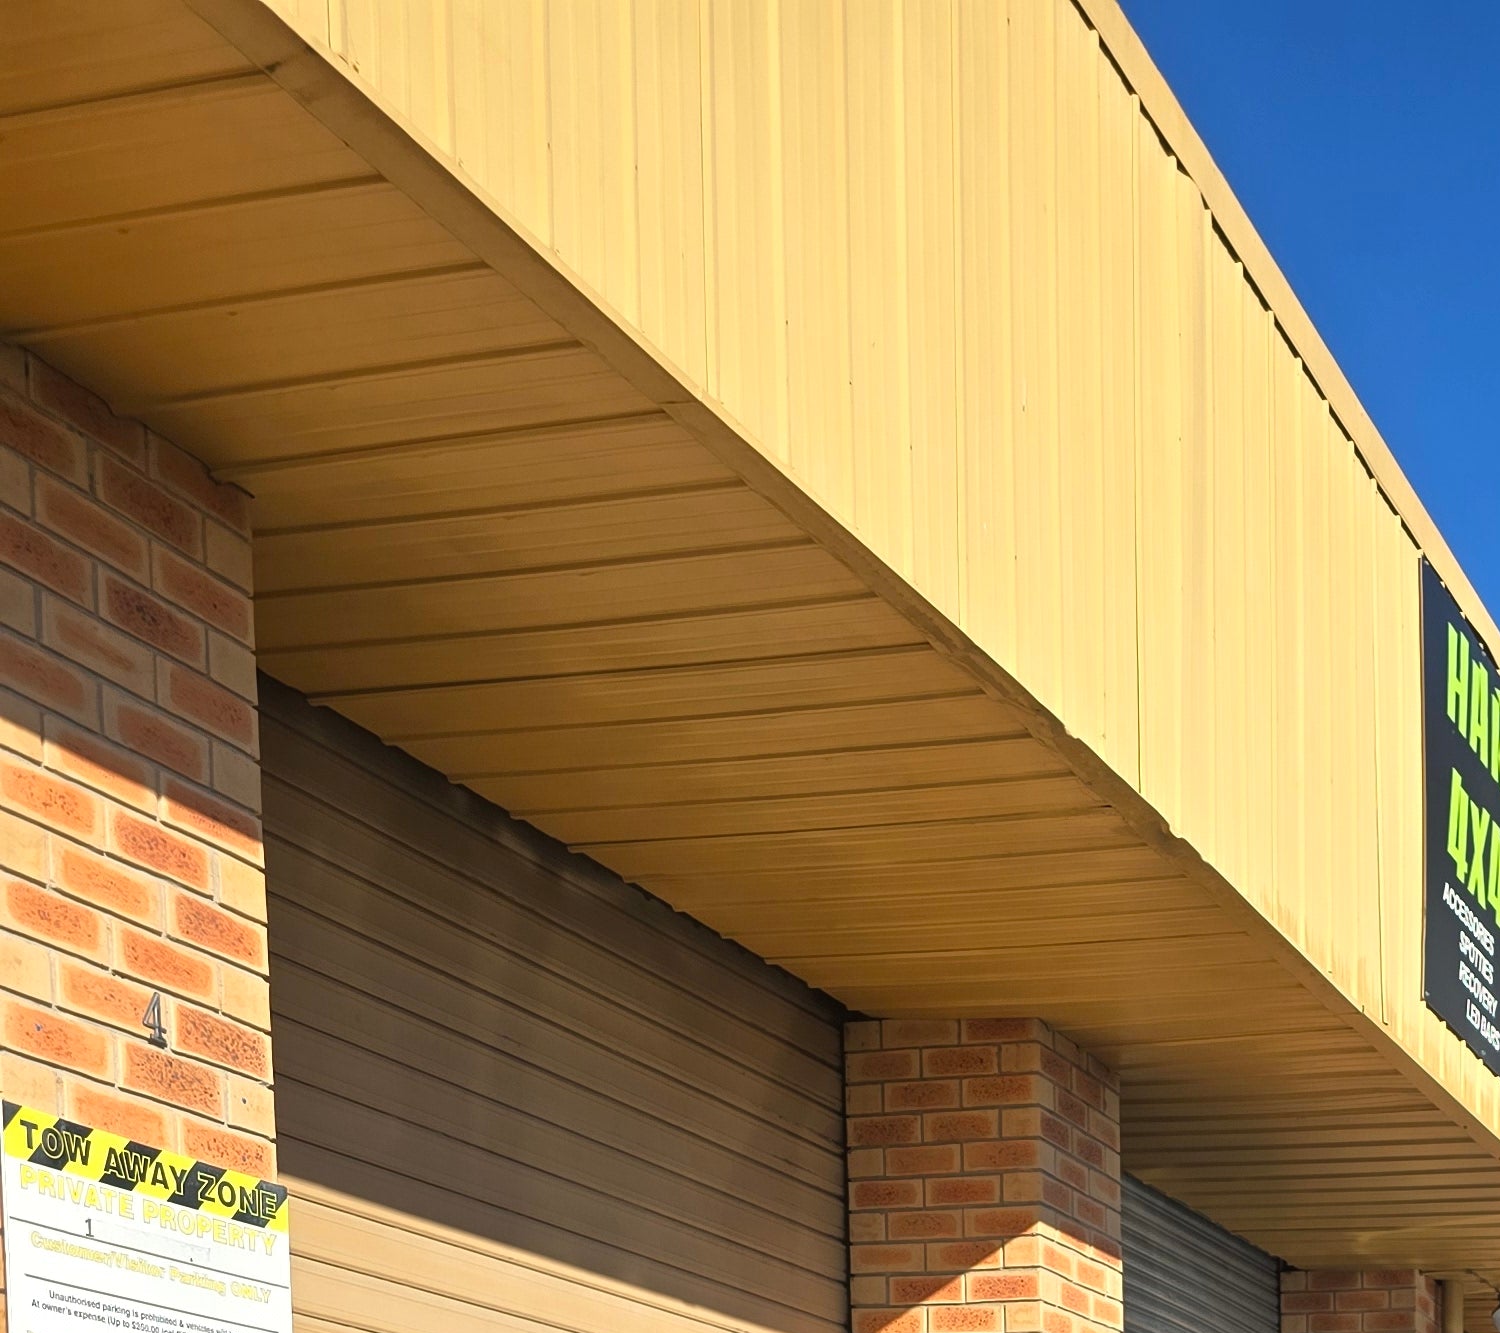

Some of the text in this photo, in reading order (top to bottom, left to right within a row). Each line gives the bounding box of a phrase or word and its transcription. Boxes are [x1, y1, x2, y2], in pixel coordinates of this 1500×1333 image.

[1443, 882, 1495, 957] ACCESSORIES
[1458, 960, 1498, 1019] RECOVERY
[1466, 999, 1481, 1031] LED
[143, 992, 167, 1044] 4
[20, 1119, 277, 1220] TOW AWAY ZONE
[20, 1163, 277, 1257] PRIVATE PROPERTY
[49, 1290, 101, 1310] Unauthorised
[102, 1303, 131, 1319] parking
[132, 1309, 139, 1319] is
[179, 1319, 184, 1329] &
[169, 1265, 227, 1297] Parking
[231, 1281, 272, 1305] ONLY
[42, 1303, 72, 1317] owner's
[74, 1309, 106, 1324] expense
[122, 1320, 130, 1329] to
